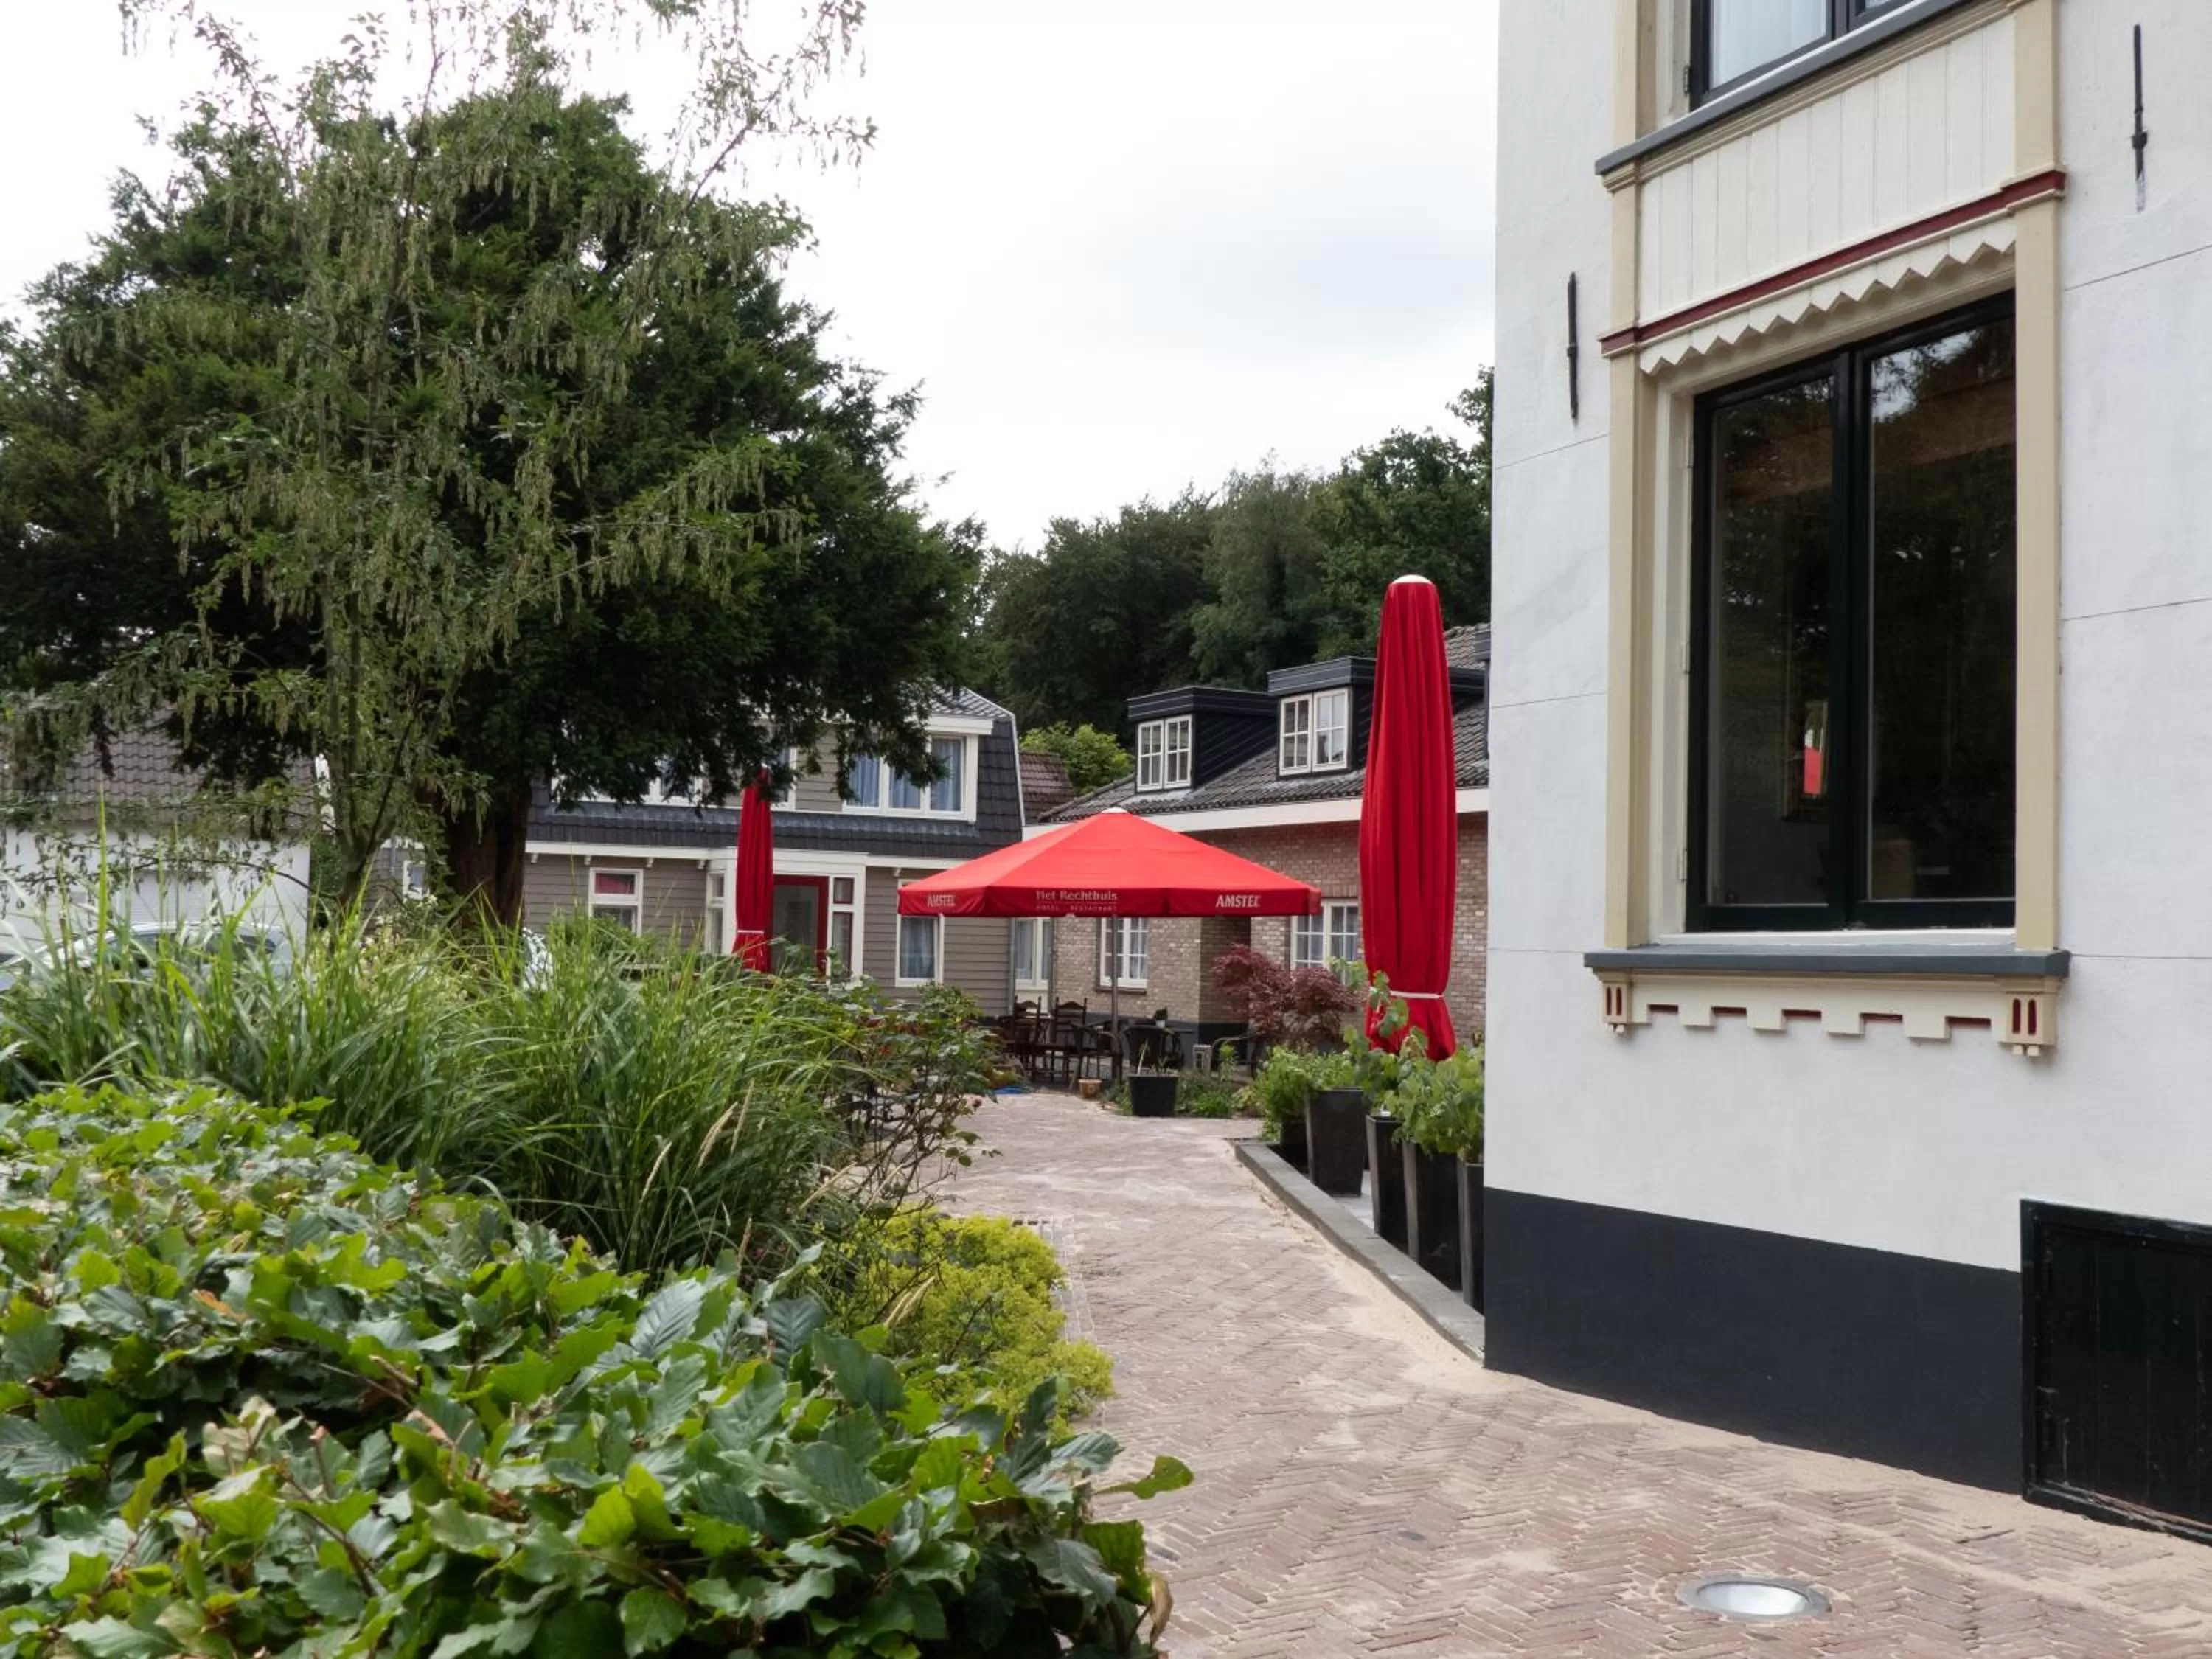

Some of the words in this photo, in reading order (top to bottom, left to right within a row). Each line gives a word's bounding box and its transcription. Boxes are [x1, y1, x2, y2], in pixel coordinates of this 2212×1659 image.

[927, 894, 956, 907] AMSTEL
[1060, 890, 1117, 900] Rechthuis
[1215, 894, 1261, 908] AMSTEL
